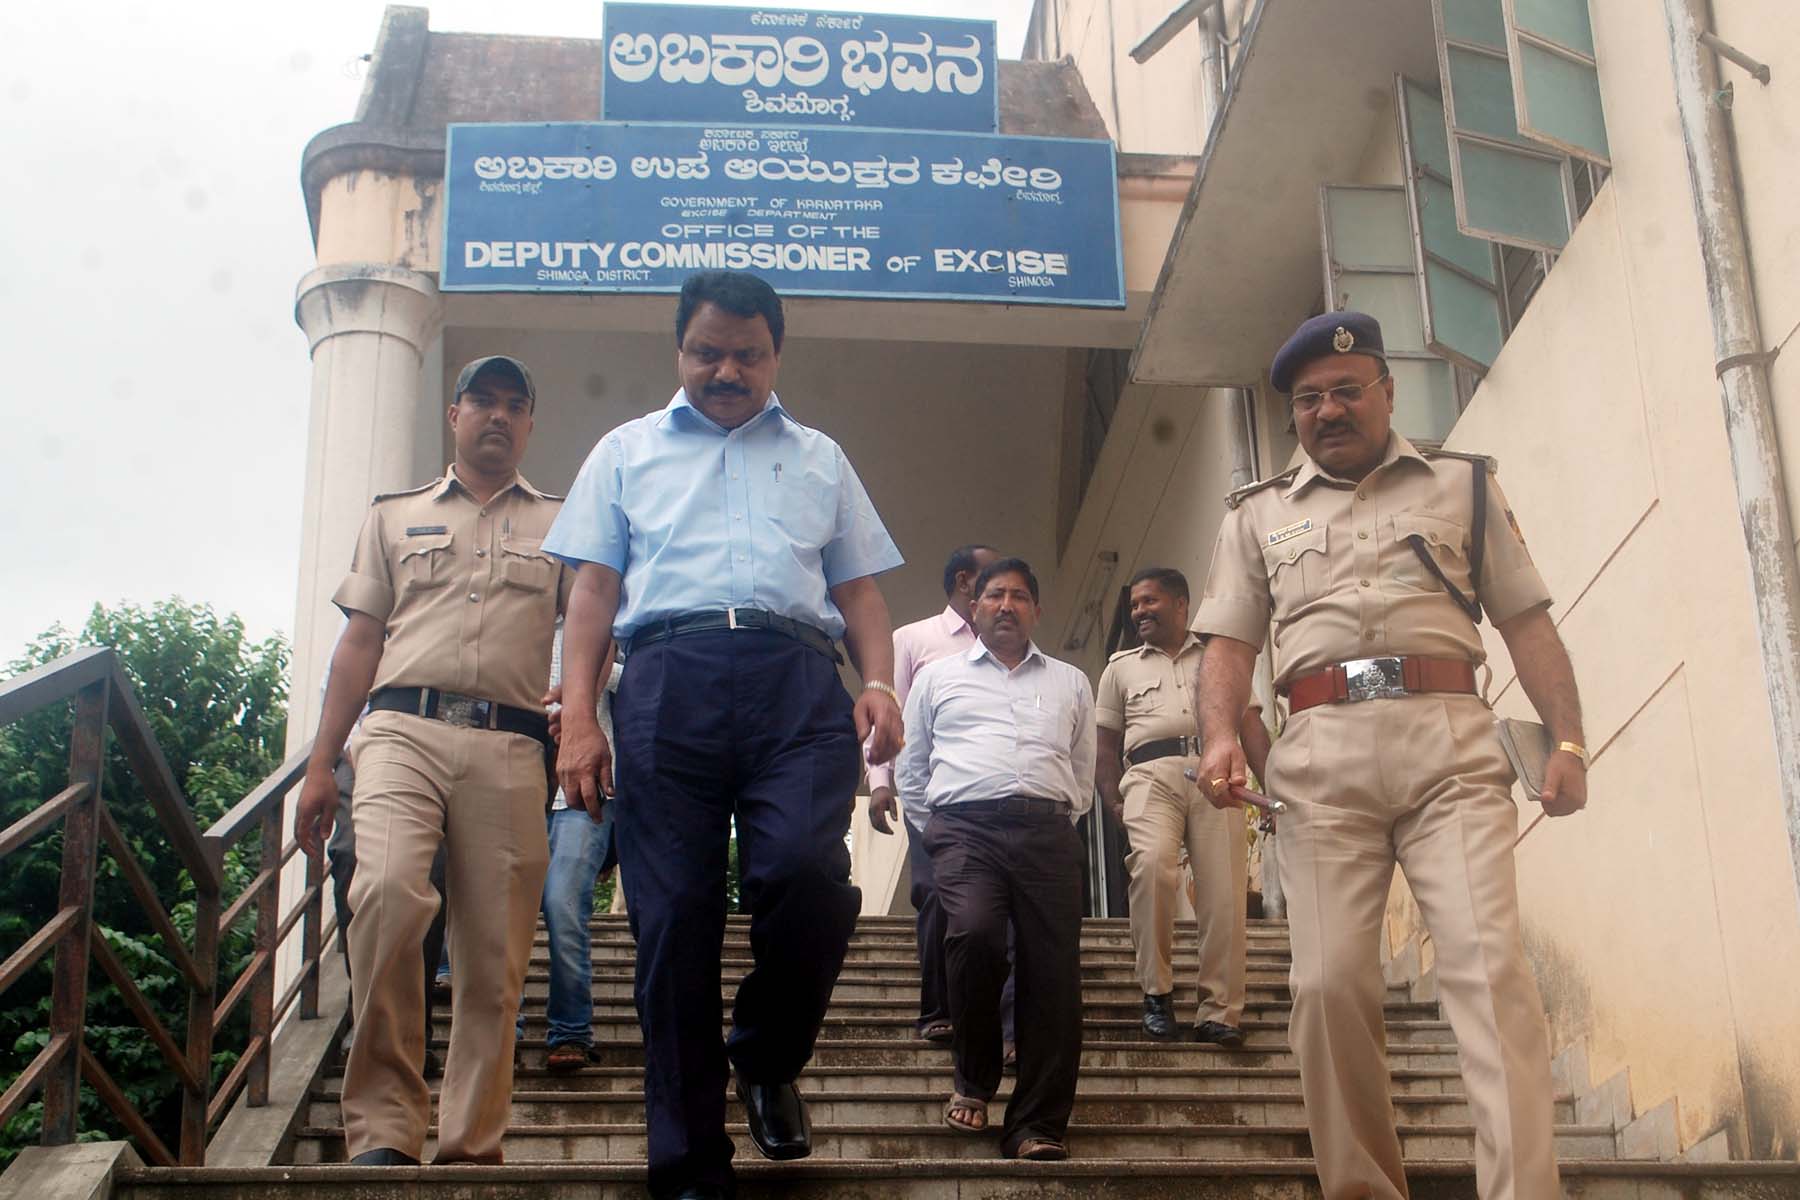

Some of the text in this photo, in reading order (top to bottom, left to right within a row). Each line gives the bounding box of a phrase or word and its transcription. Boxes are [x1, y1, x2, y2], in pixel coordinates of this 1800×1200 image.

[609, 30, 984, 95] ಅಬಕಾರಿ ಭವನ
[474, 155, 617, 181] ಅಬಕಾರಿ
[630, 151, 711, 180] ಉಪ
[660, 197, 883, 211] GOVERNMENT OF KARNATAKA
[681, 209, 838, 221] EXCISE DEPARTMENT
[661, 223, 880, 240] OFFICE OF THE
[464, 241, 1068, 276] DEPUTY COMMISSIONER OF EXCISE
[536, 269, 651, 282] SHIMOGA DISTRICT
[1008, 275, 1056, 289] SHIMOGA
